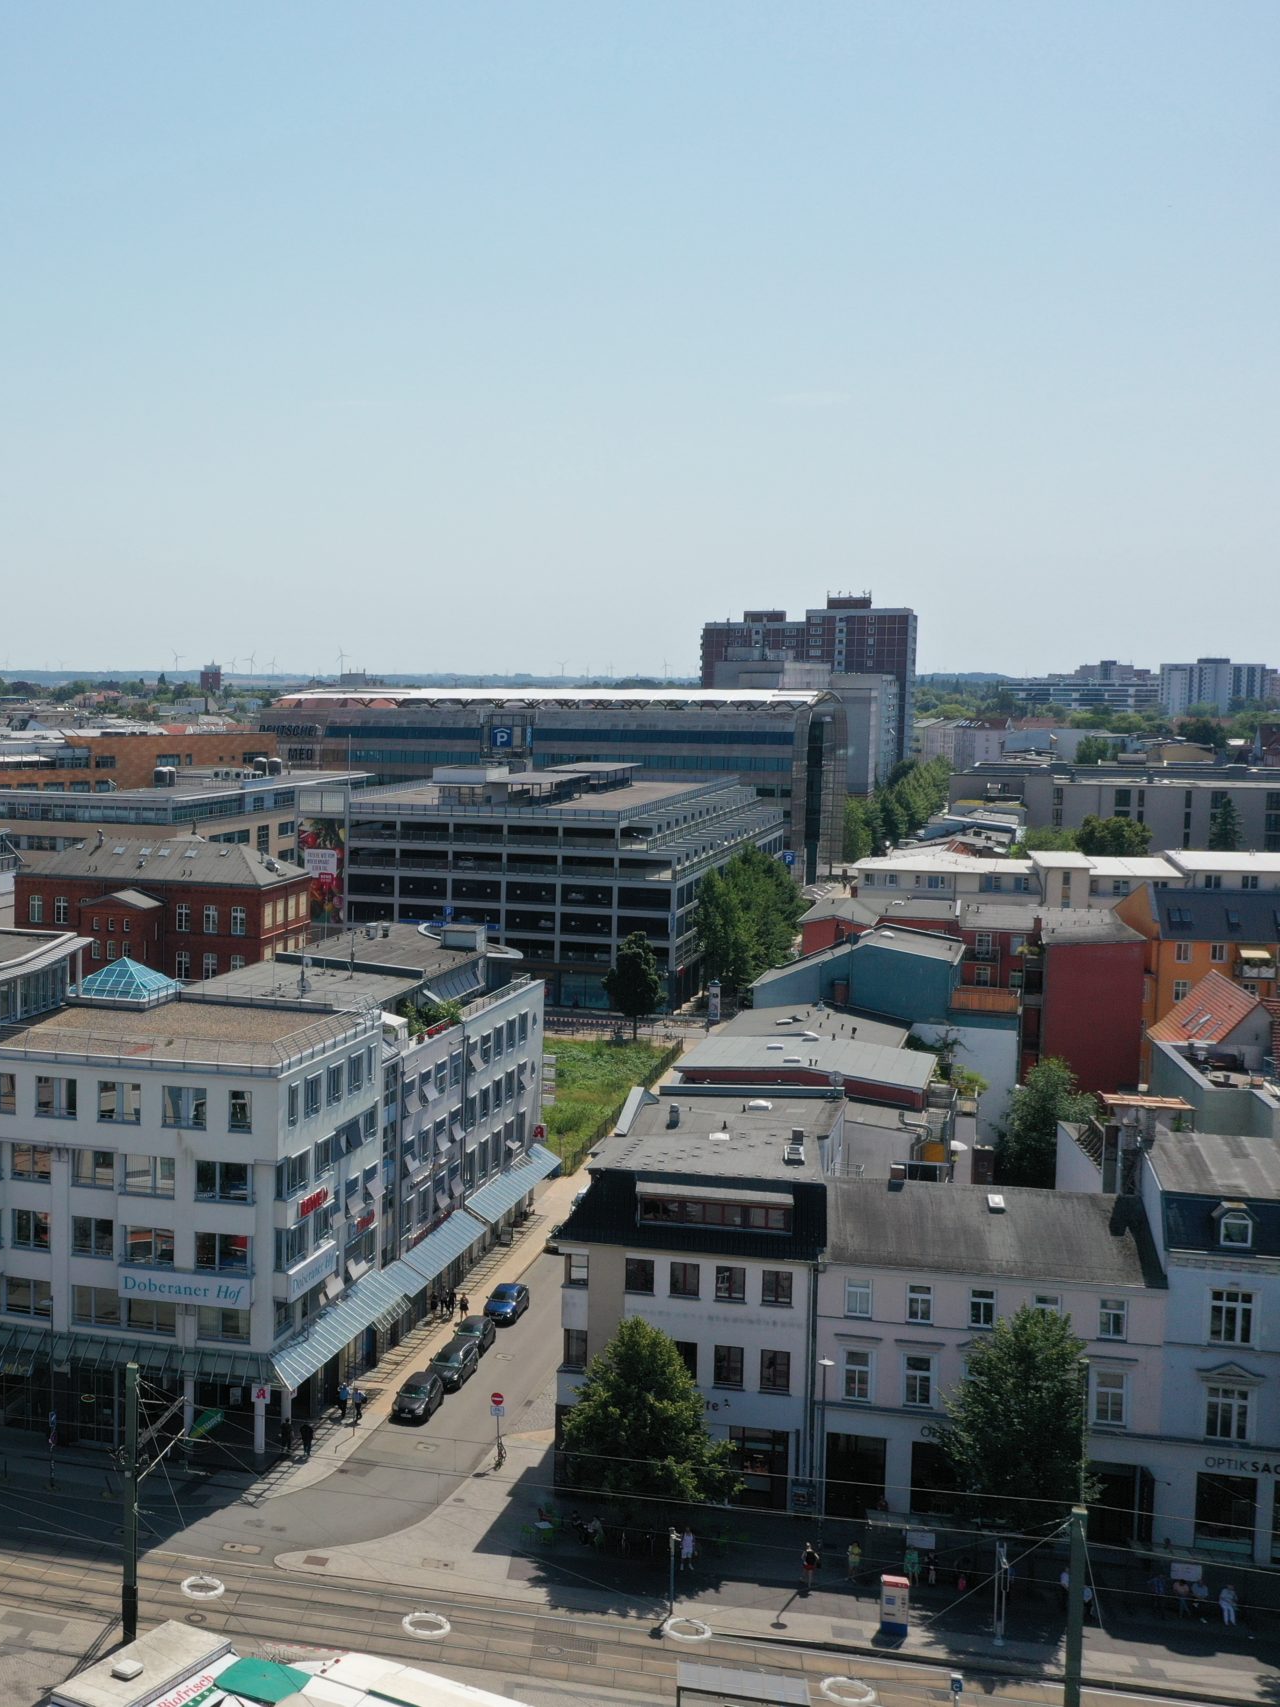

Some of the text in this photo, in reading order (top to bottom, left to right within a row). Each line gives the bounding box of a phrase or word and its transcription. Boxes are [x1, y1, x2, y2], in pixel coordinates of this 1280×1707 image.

[497, 732, 508, 746] P
[288, 747, 313, 761] MED
[124, 1276, 244, 1305] Doberaner Hof
[157, 1673, 214, 1707] Biofrisch
